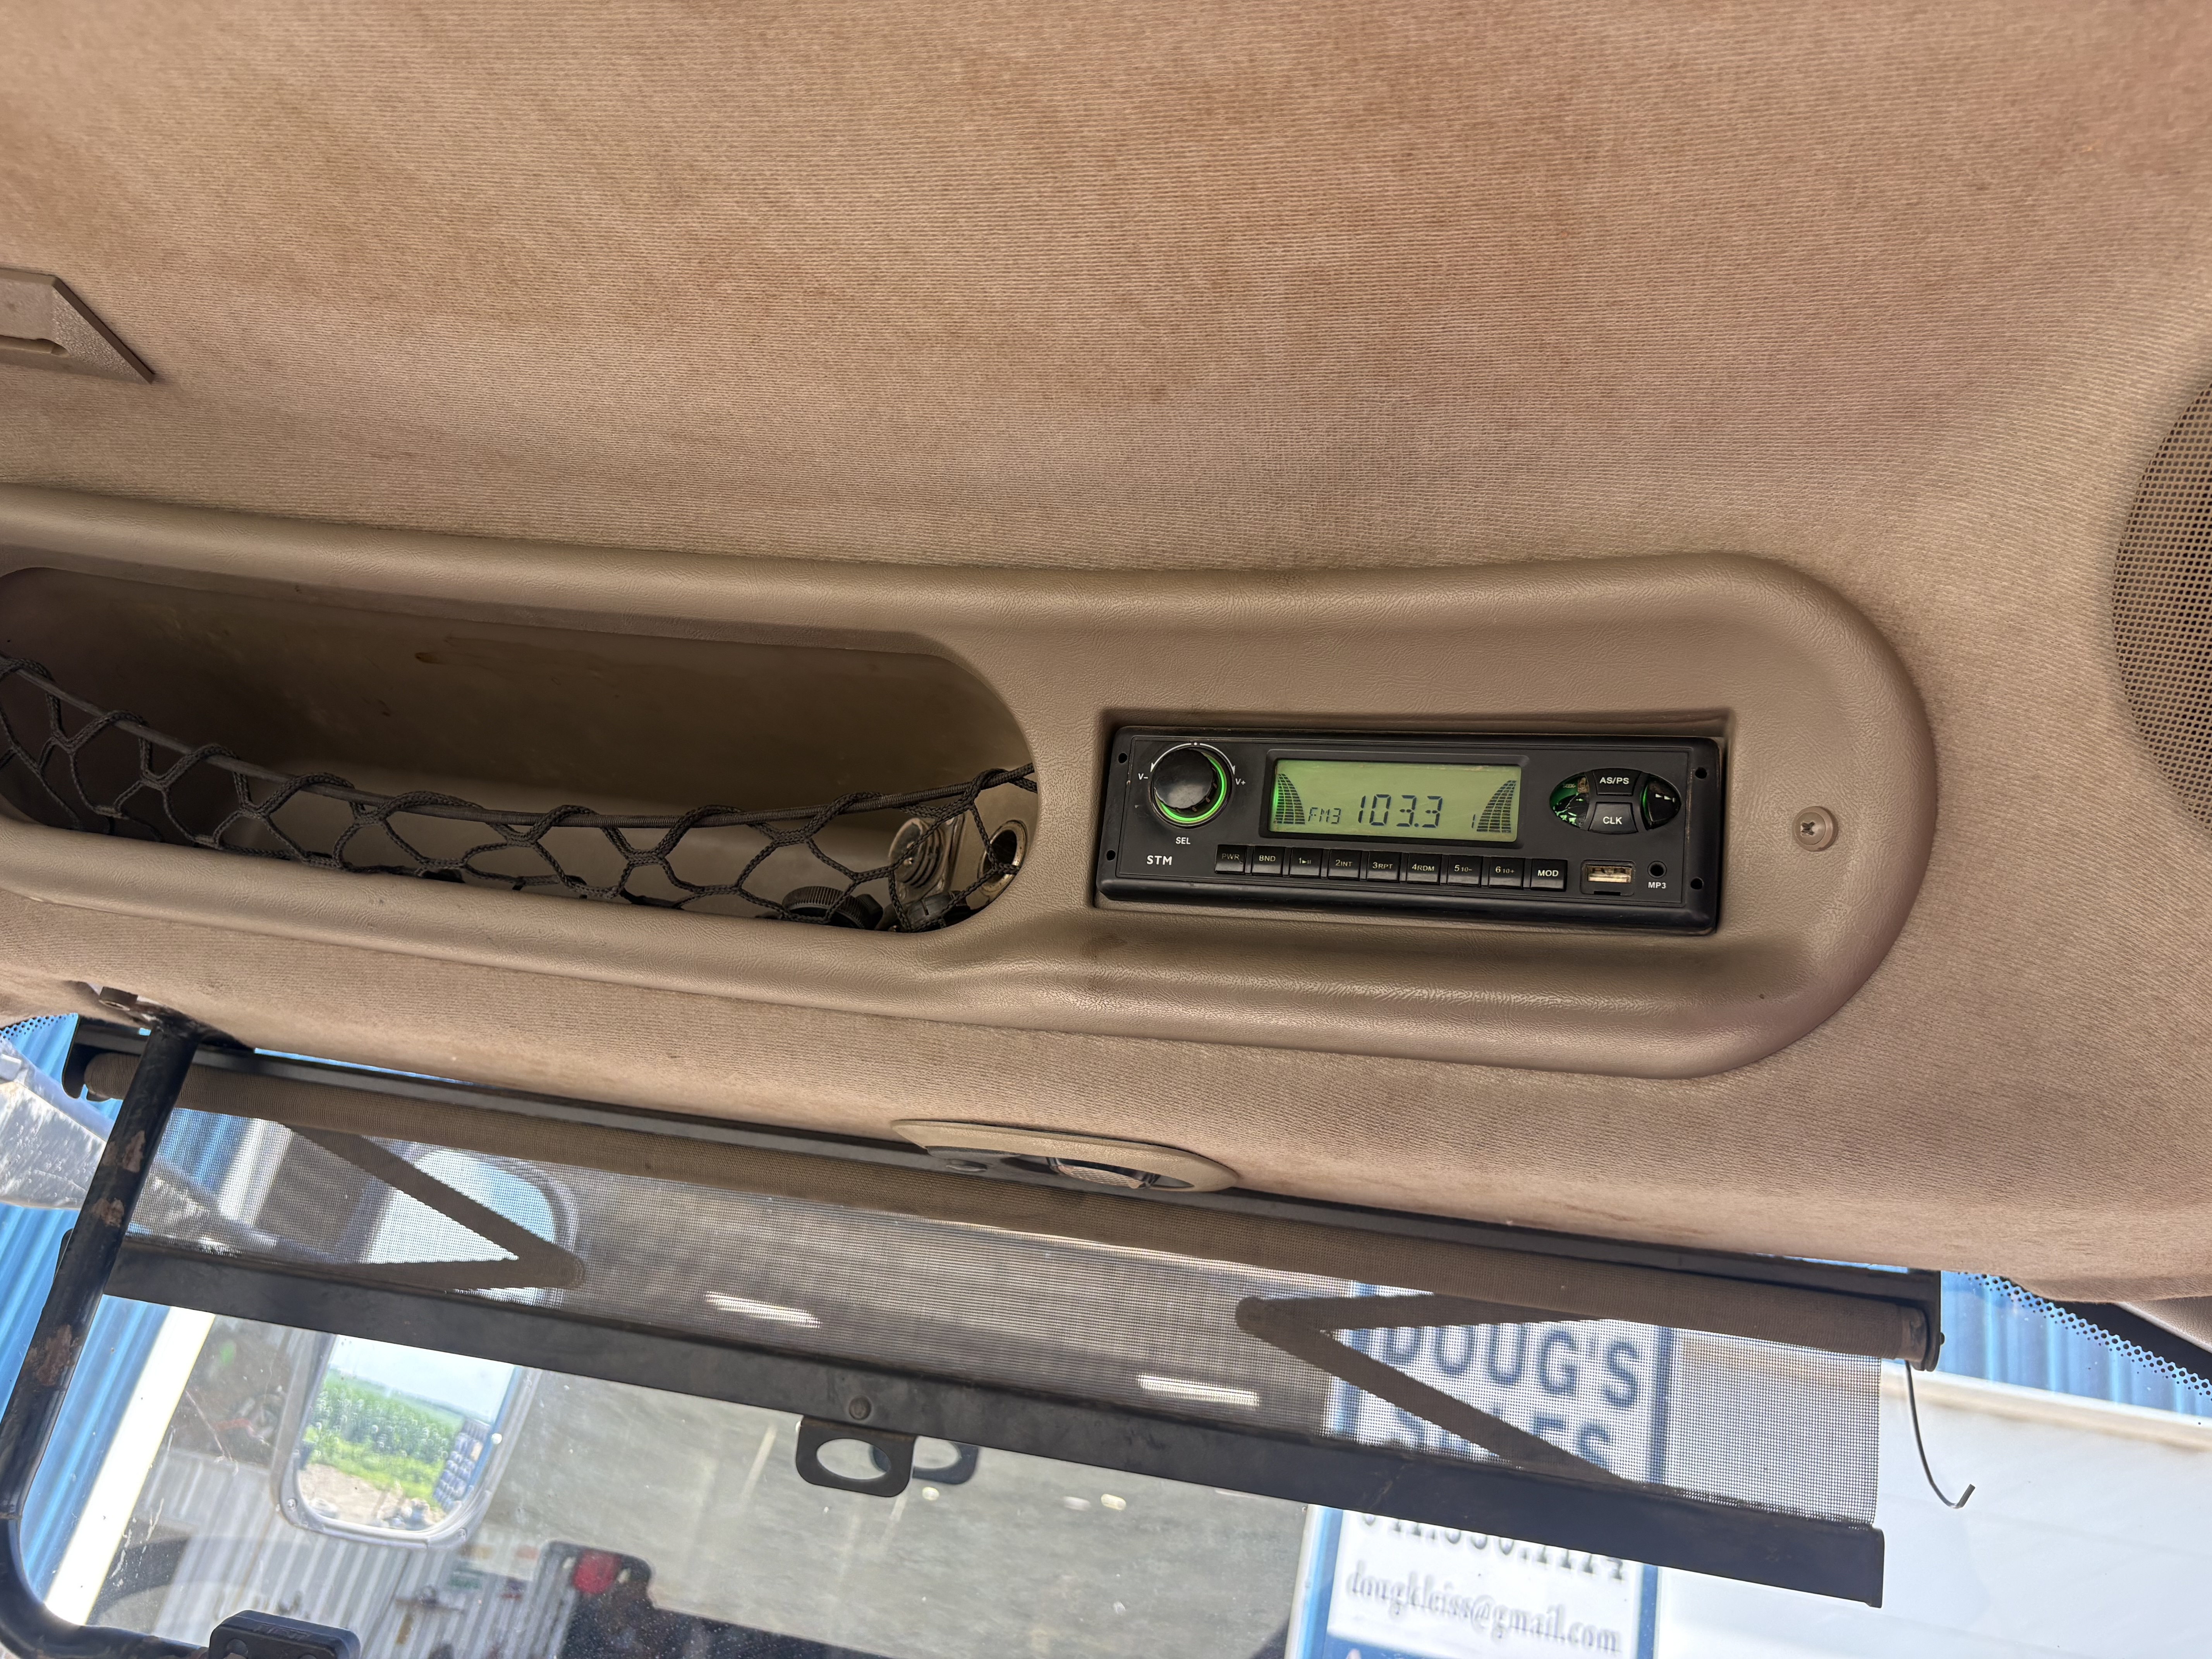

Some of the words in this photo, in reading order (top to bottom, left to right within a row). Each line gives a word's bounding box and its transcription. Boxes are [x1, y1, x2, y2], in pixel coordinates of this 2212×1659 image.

[1308, 807, 1341, 824] FM3
[1358, 794, 1443, 828] 103.3
[1603, 816, 1623, 824] CLK
[1146, 855, 1172, 866] STM
